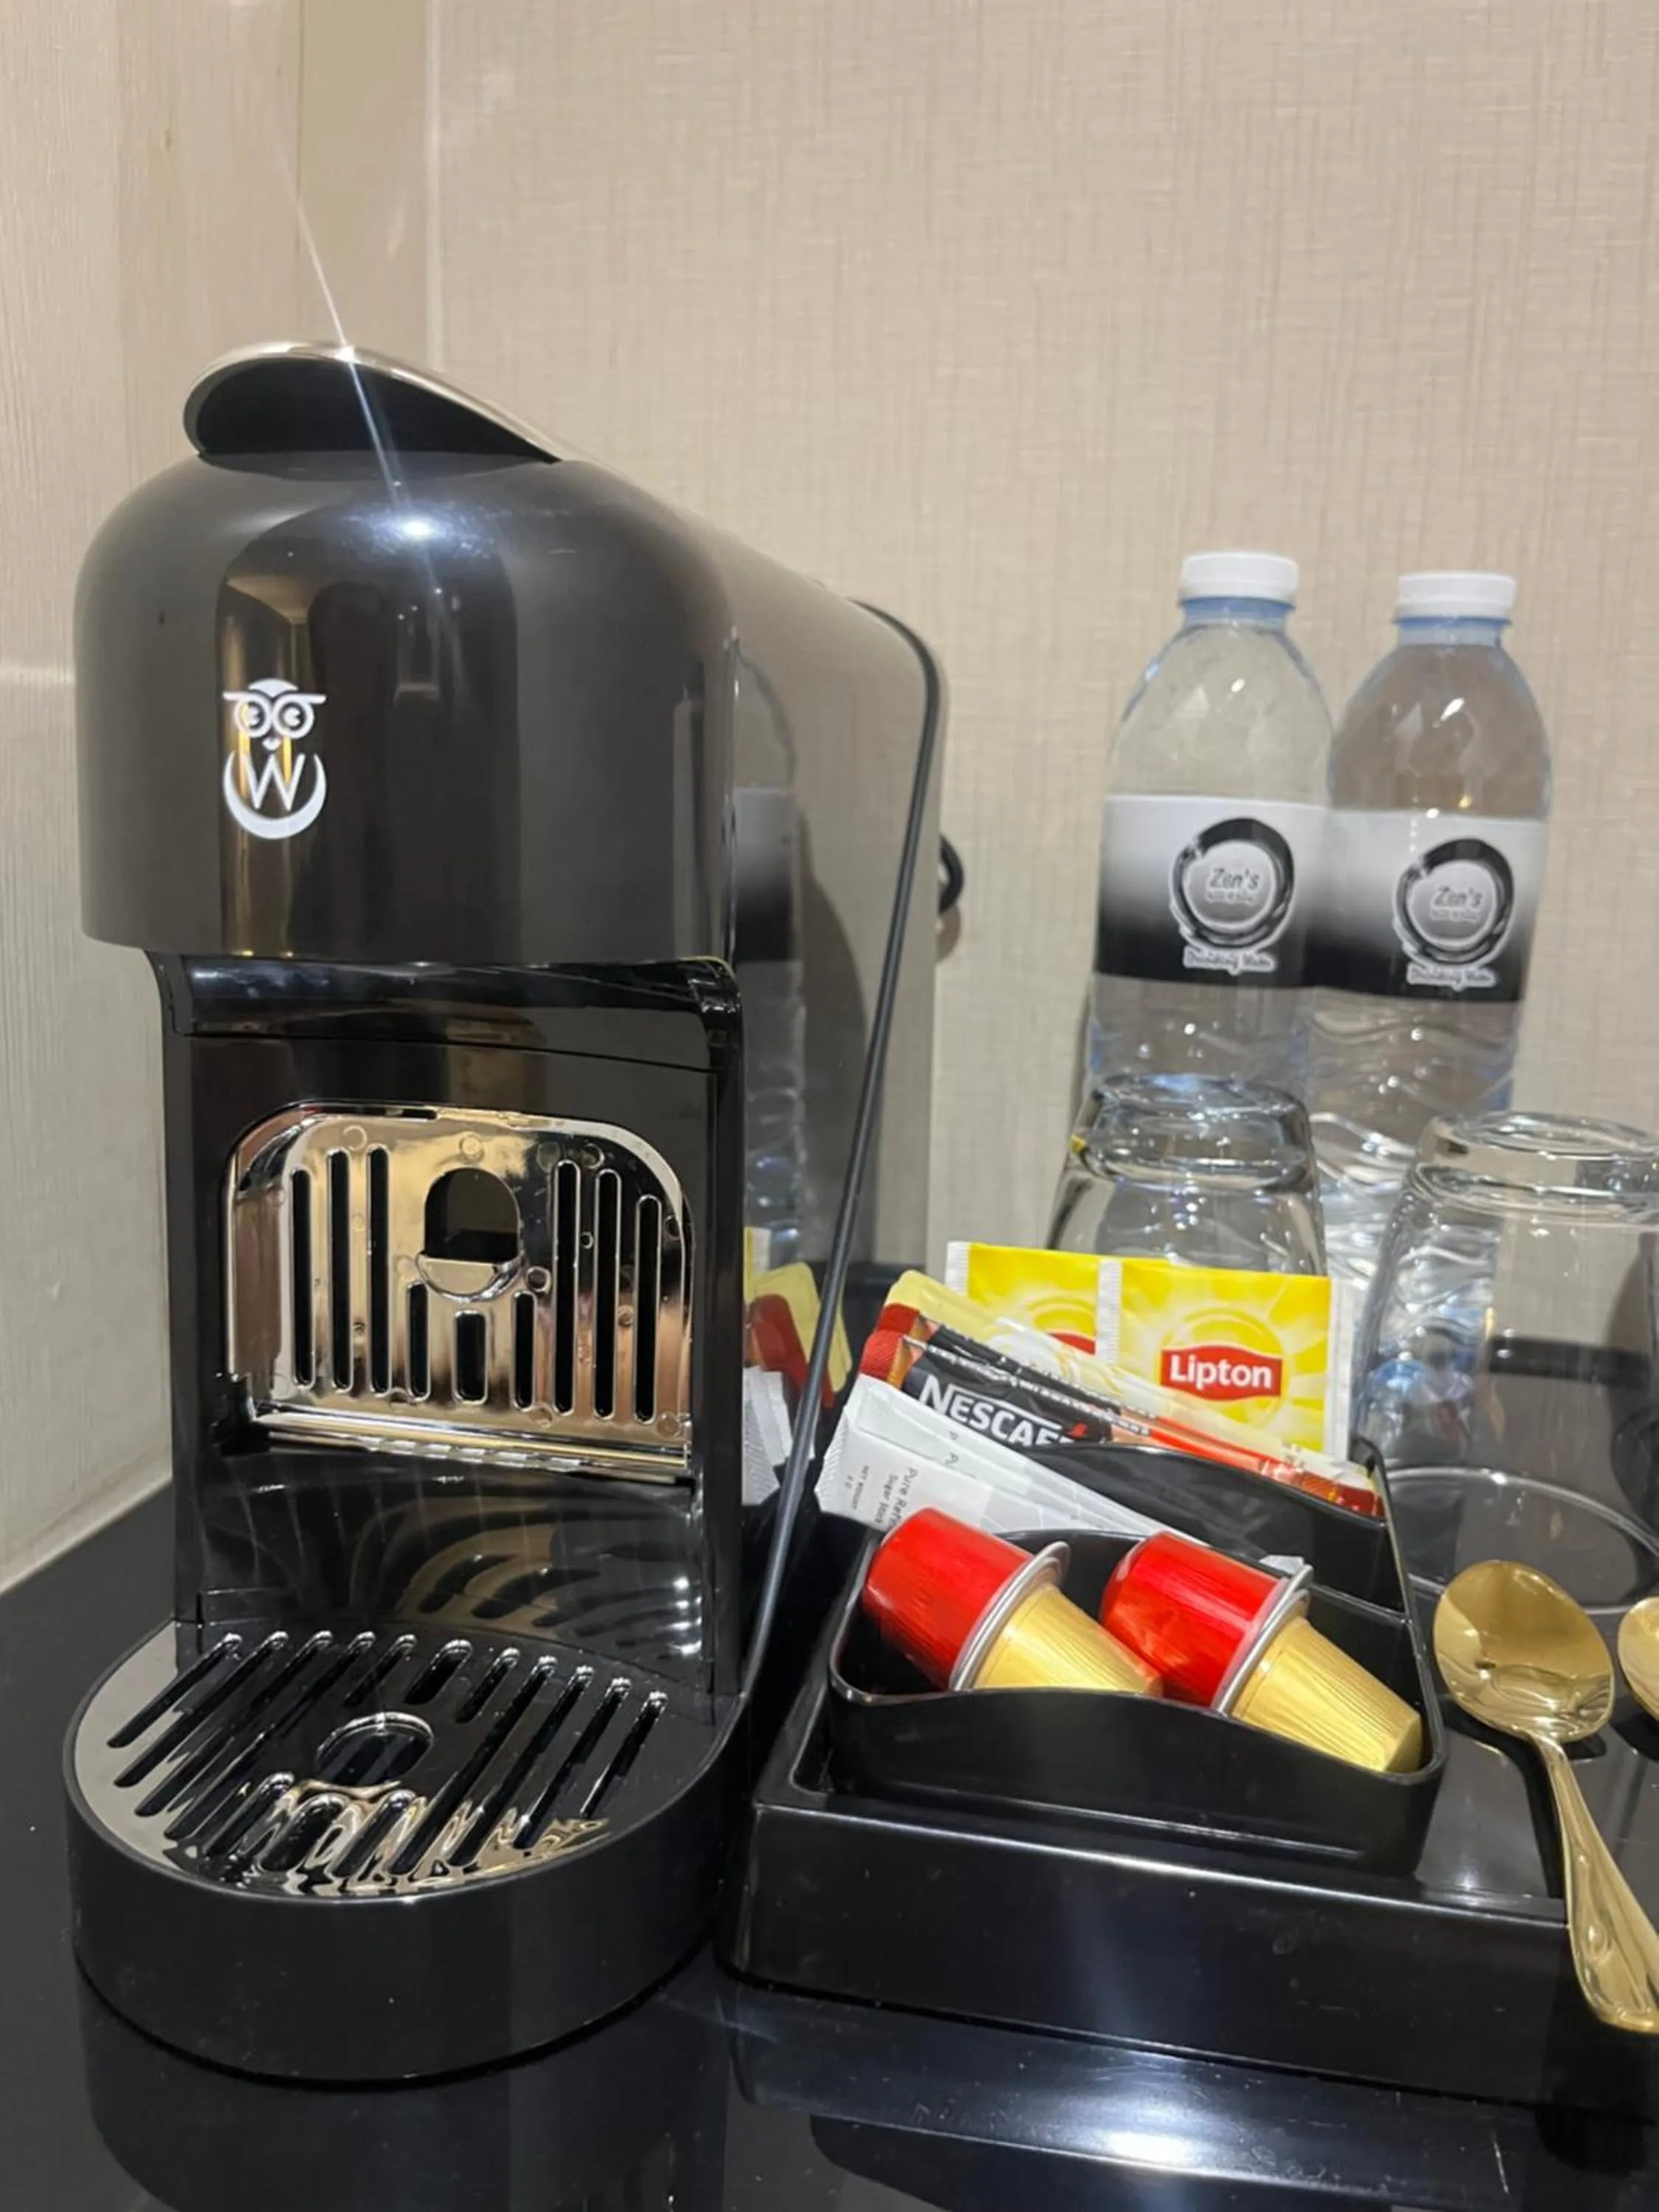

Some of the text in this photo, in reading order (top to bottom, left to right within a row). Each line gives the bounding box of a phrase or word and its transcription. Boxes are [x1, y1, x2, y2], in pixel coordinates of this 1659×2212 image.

[243, 752, 306, 810] W
[1169, 1354, 1273, 1391] Lipton
[899, 1467, 918, 1495] Pure
